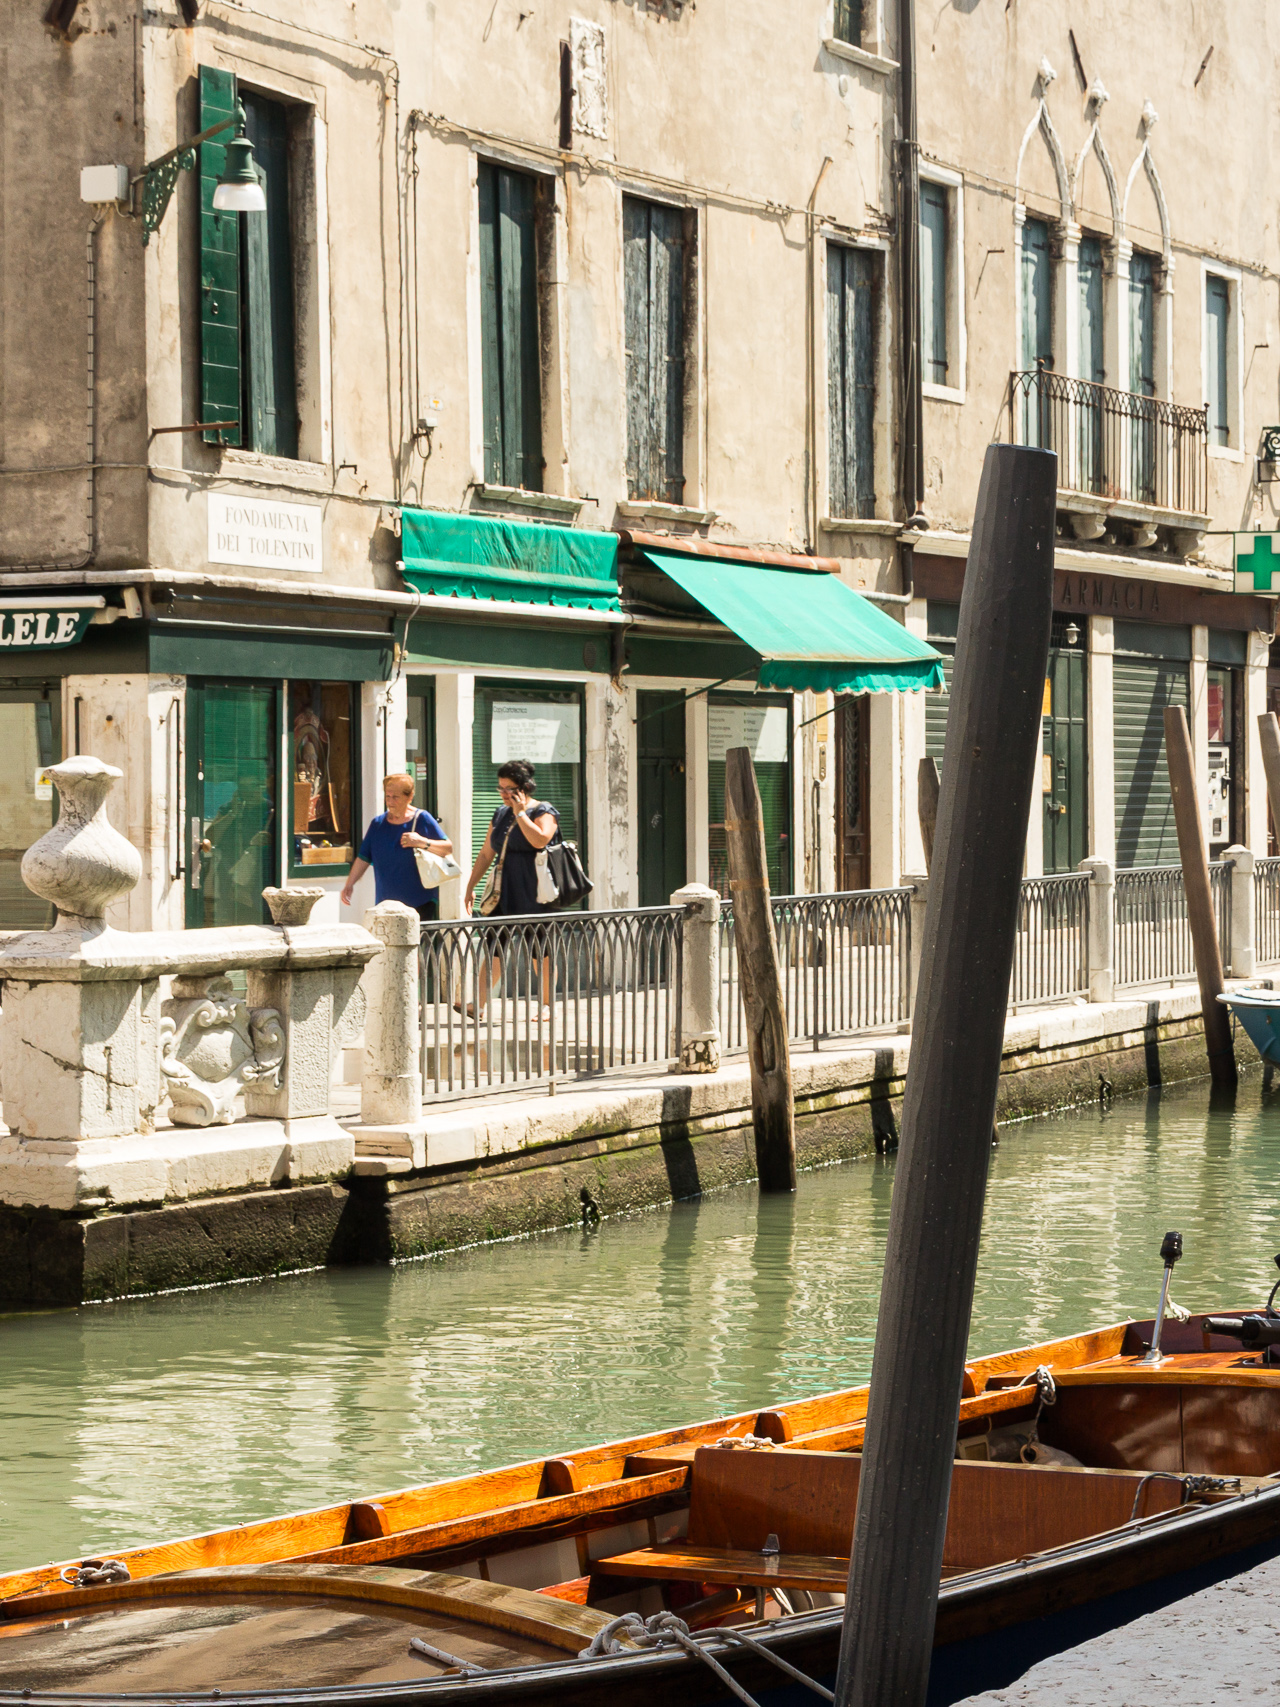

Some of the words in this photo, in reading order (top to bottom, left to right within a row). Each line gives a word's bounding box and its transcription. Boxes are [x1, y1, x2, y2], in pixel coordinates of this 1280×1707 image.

[225, 506, 309, 533] FONDAMENTA
[217, 532, 240, 552] DEI
[248, 537, 315, 560] TOLENTINI
[1053, 575, 1160, 612] ARMACIA
[0, 612, 80, 646] LELE
